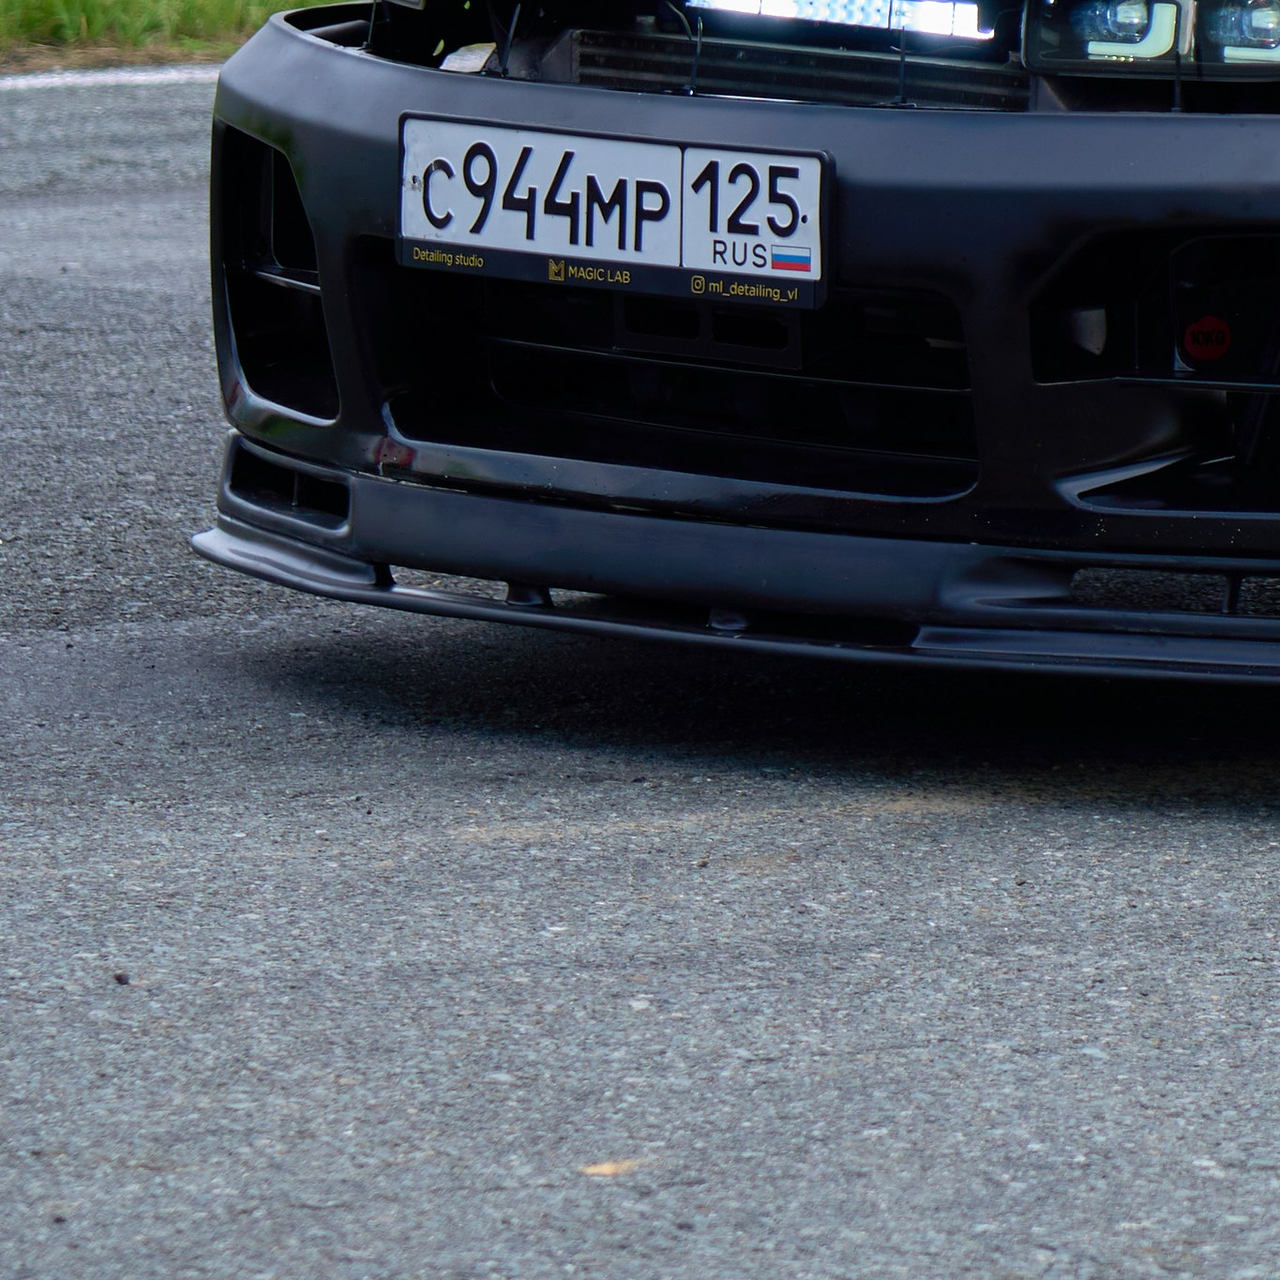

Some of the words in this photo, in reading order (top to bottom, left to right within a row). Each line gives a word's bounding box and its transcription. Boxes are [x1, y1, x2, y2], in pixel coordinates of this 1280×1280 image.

[691, 160, 800, 238] 125
[413, 247, 452, 266] Detailing
[454, 252, 484, 268] studio
[712, 240, 768, 268] RUS
[568, 267, 605, 283] MAGIC
[606, 269, 631, 285] LAB
[708, 279, 798, 301] ml_detailing_vl
